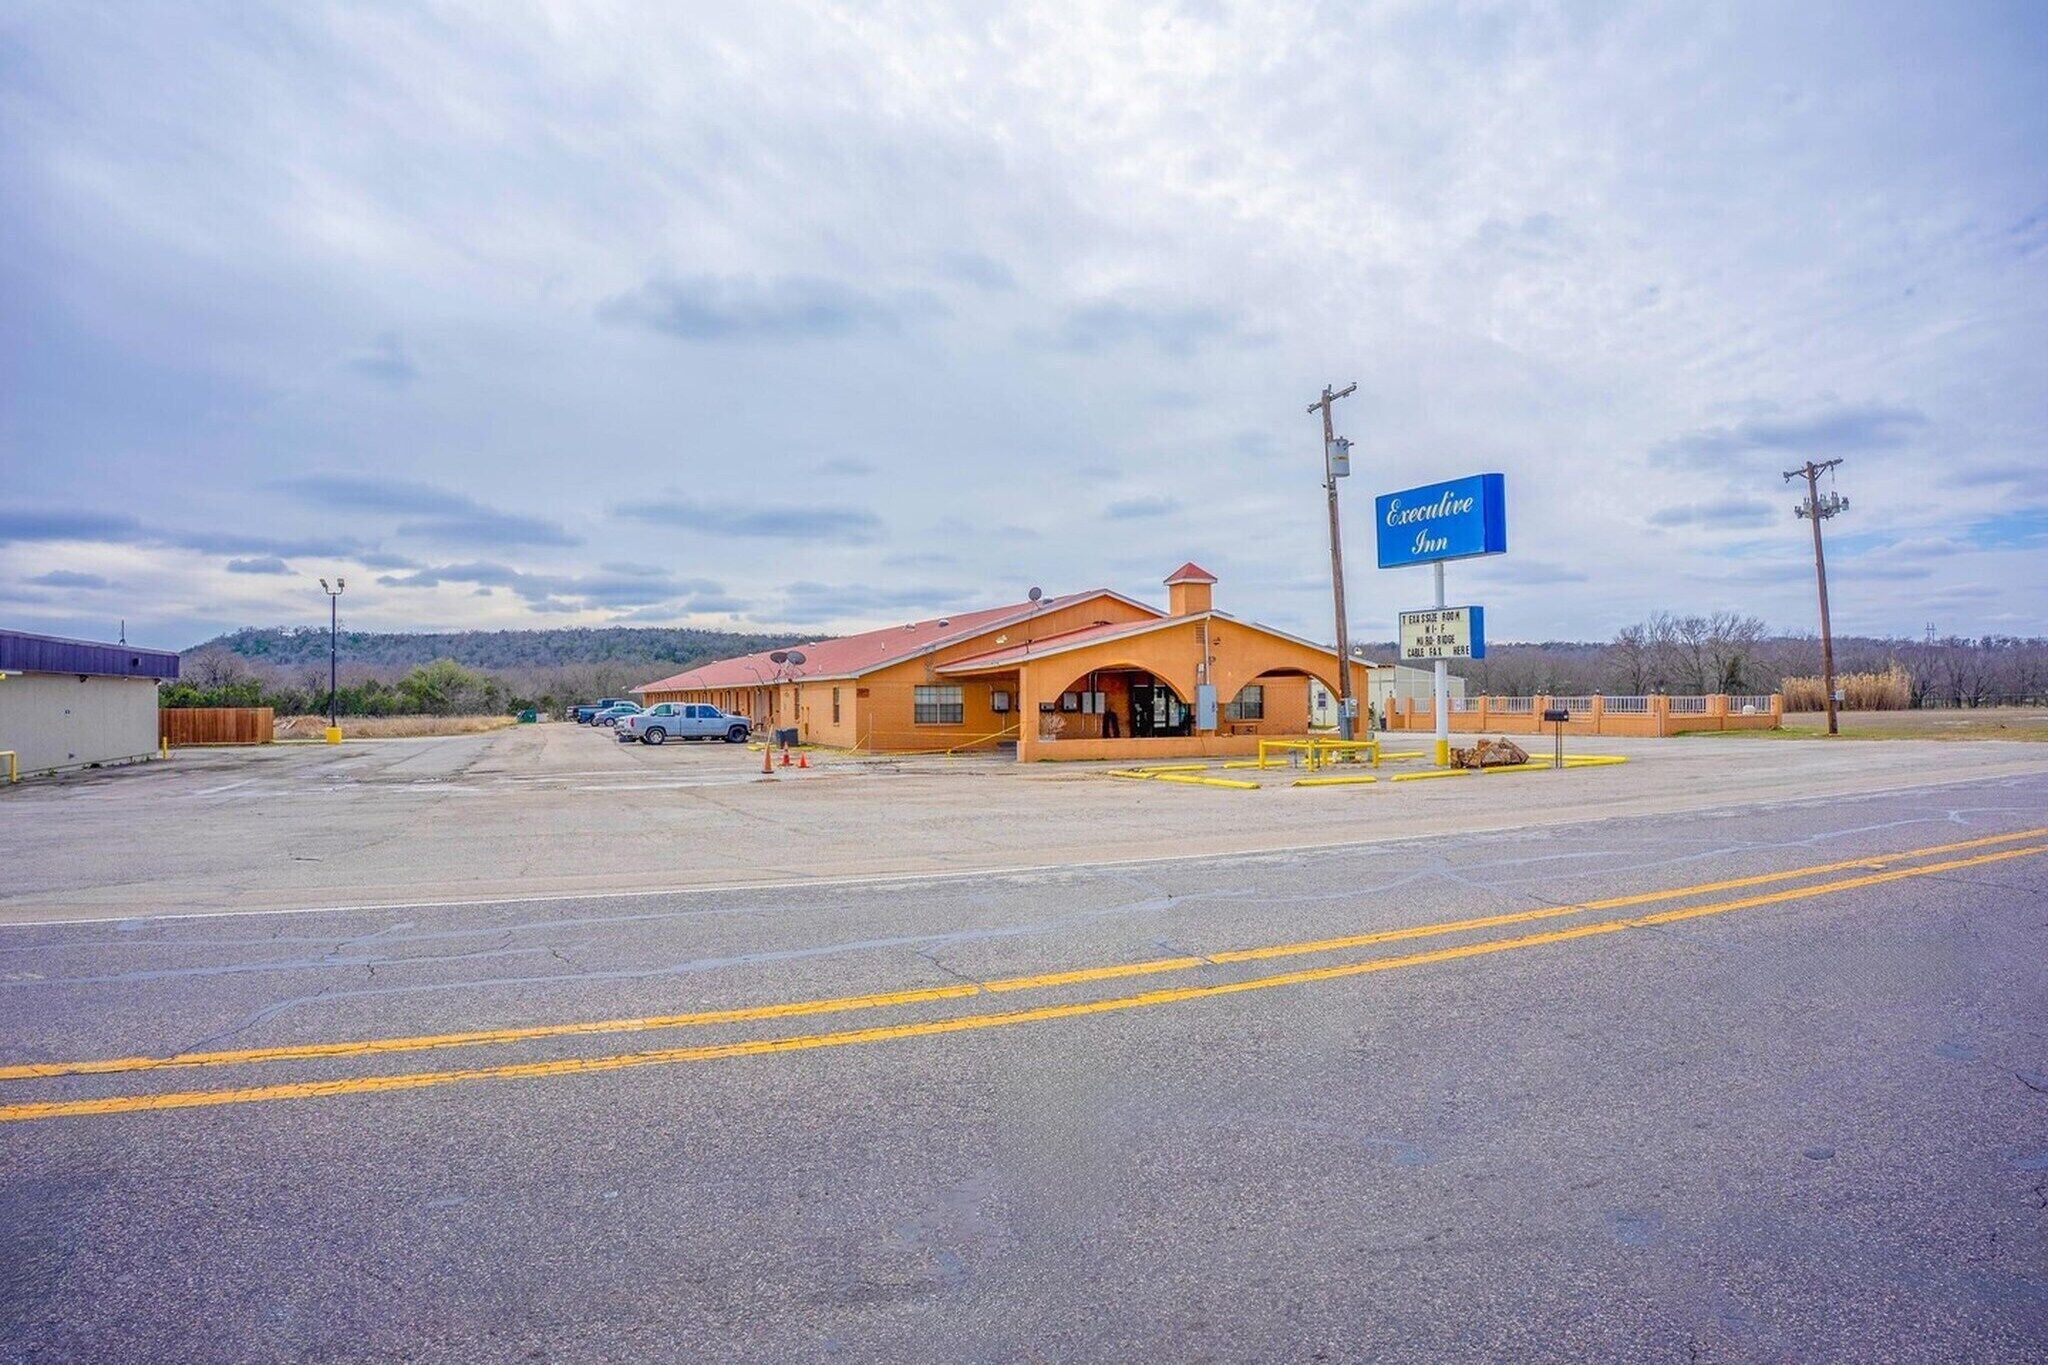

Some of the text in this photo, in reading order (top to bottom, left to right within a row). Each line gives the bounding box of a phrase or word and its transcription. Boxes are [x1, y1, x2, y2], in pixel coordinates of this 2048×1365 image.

[1386, 490, 1473, 527] Executive
[1411, 528, 1448, 555] Inn
[1407, 645, 1470, 658] CABLE FAX HERE
